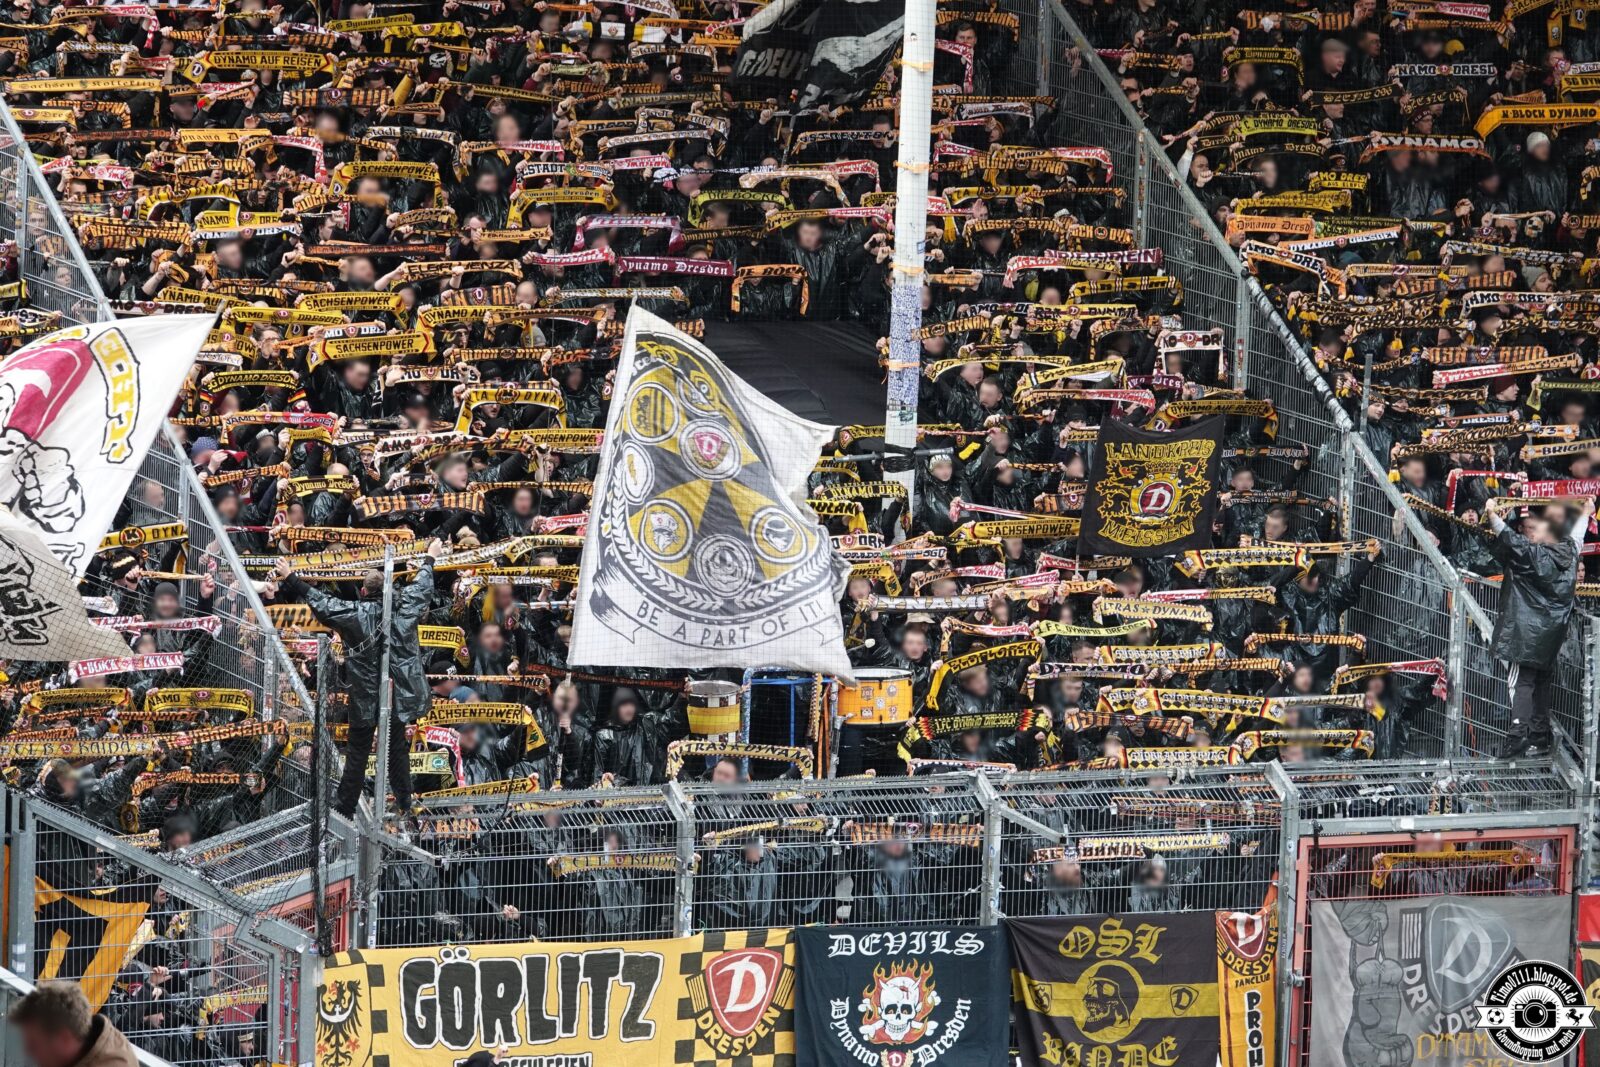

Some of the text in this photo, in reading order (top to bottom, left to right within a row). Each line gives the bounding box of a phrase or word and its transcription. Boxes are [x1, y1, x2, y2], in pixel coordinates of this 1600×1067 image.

[214, 55, 321, 67] DYNAMO AUF REISEN
[1549, 109, 1597, 118] DYNAMO
[1379, 136, 1478, 149] DYNAMO
[675, 261, 727, 275] Dresden
[306, 296, 391, 310] SACHSENPOWER
[425, 308, 467, 322] DYNAMO
[336, 339, 414, 352] SACHSENPOWER
[219, 374, 259, 384] DYNAMO
[1104, 439, 1216, 461] LANDKREIS
[1099, 518, 1194, 546] MEISSEN
[638, 599, 826, 647] BE A PART OF IT!
[423, 707, 522, 721] SACHSENPOWER
[828, 930, 985, 958] DEVILS
[1058, 918, 1167, 965] OSL
[1225, 930, 1279, 974] DRESDEN
[399, 946, 664, 1050] GÖRLITZ
[1402, 963, 1486, 1035] DRESDE
[696, 1005, 781, 1056] DRESDEN
[829, 996, 880, 1067] Dynamo
[912, 998, 972, 1067] Dresden
